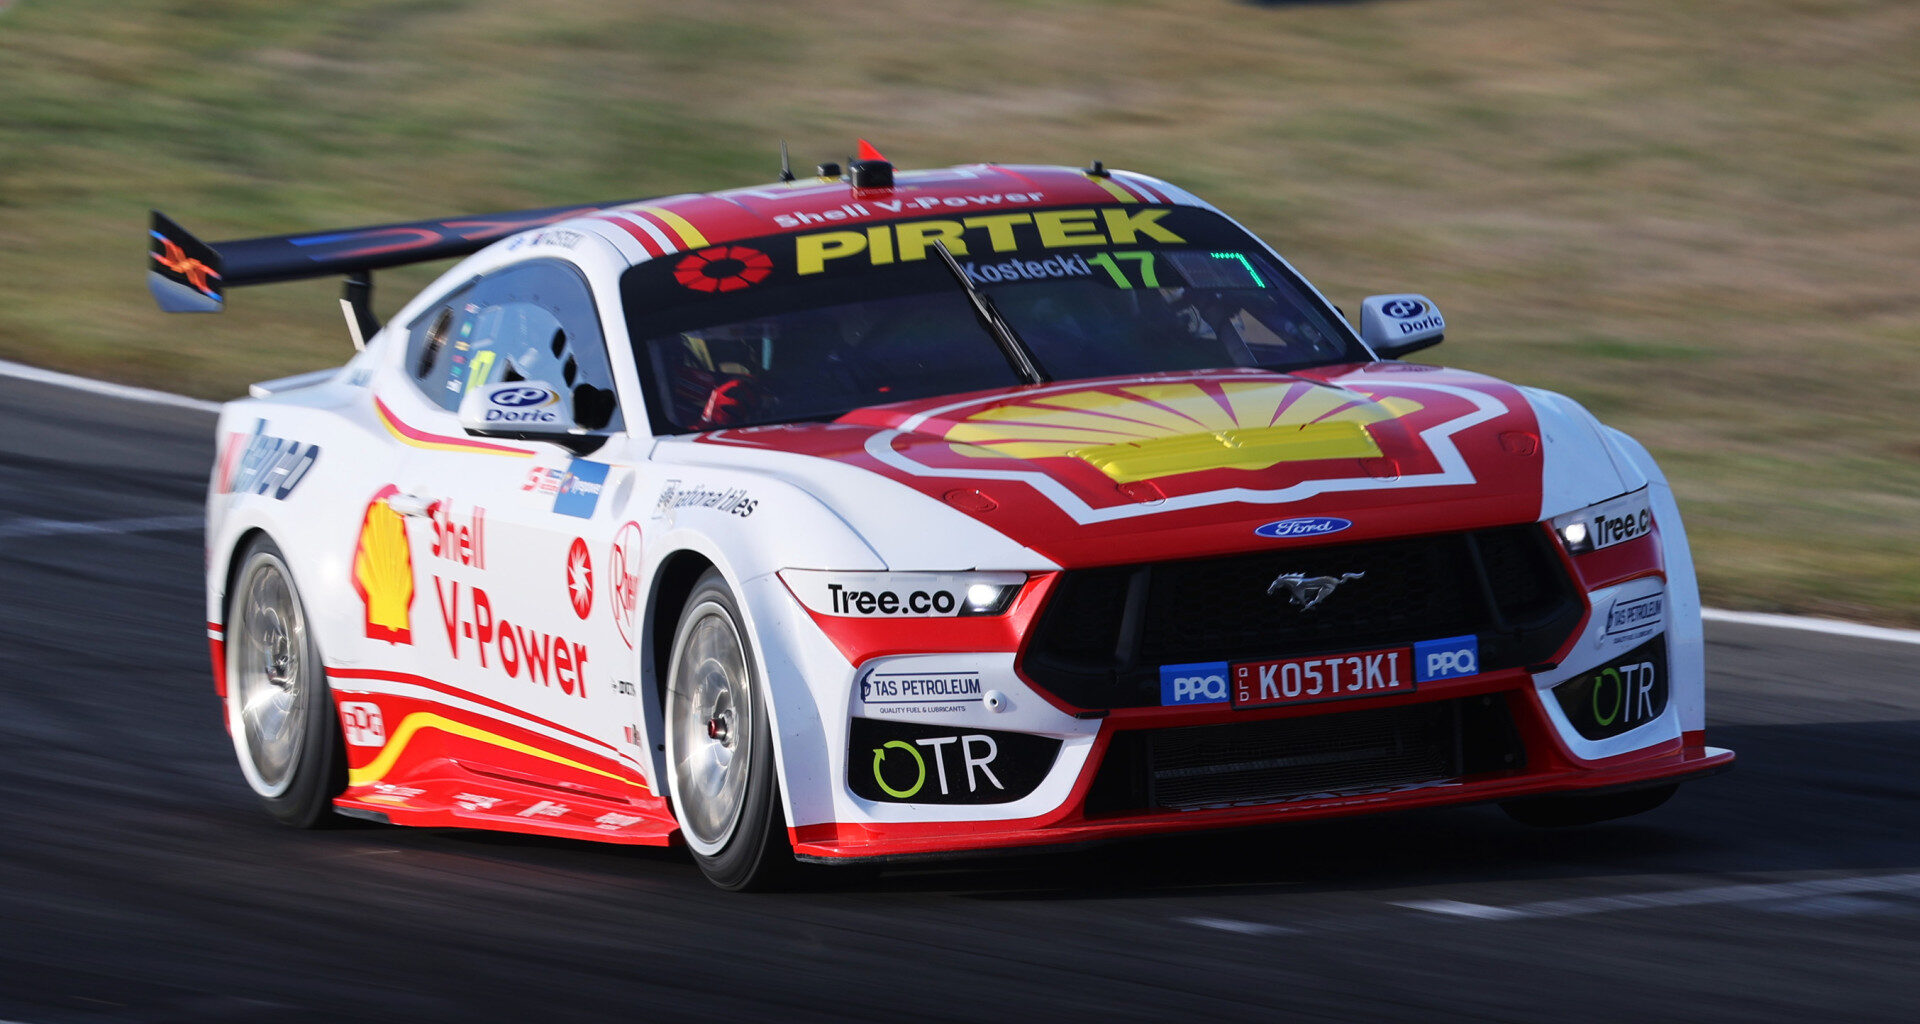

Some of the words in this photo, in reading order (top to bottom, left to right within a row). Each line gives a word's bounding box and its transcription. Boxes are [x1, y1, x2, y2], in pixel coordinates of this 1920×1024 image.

[773, 202, 870, 228] Shell
[873, 190, 1044, 213] V-Power
[796, 208, 1187, 276] PIRTEK
[962, 253, 1092, 284] Kostecki
[1088, 251, 1159, 289] 17
[1400, 315, 1444, 336] Doric
[486, 408, 556, 423] Doric
[431, 498, 487, 571] Shell
[1275, 519, 1333, 535] Ford
[827, 583, 956, 615] Tree.co
[433, 574, 589, 699] V-Power
[1427, 648, 1477, 678] PPQ
[874, 680, 898, 696] TAS
[902, 678, 981, 696] PETROLEUM
[1173, 674, 1227, 702] PPQ
[1238, 667, 1249, 702] QLD
[1593, 661, 1655, 727] OTR
[880, 706, 905, 714] QUALITY
[906, 706, 921, 714] FUEL
[928, 705, 966, 713] LUBRICANTS
[872, 733, 1005, 799] OTR
